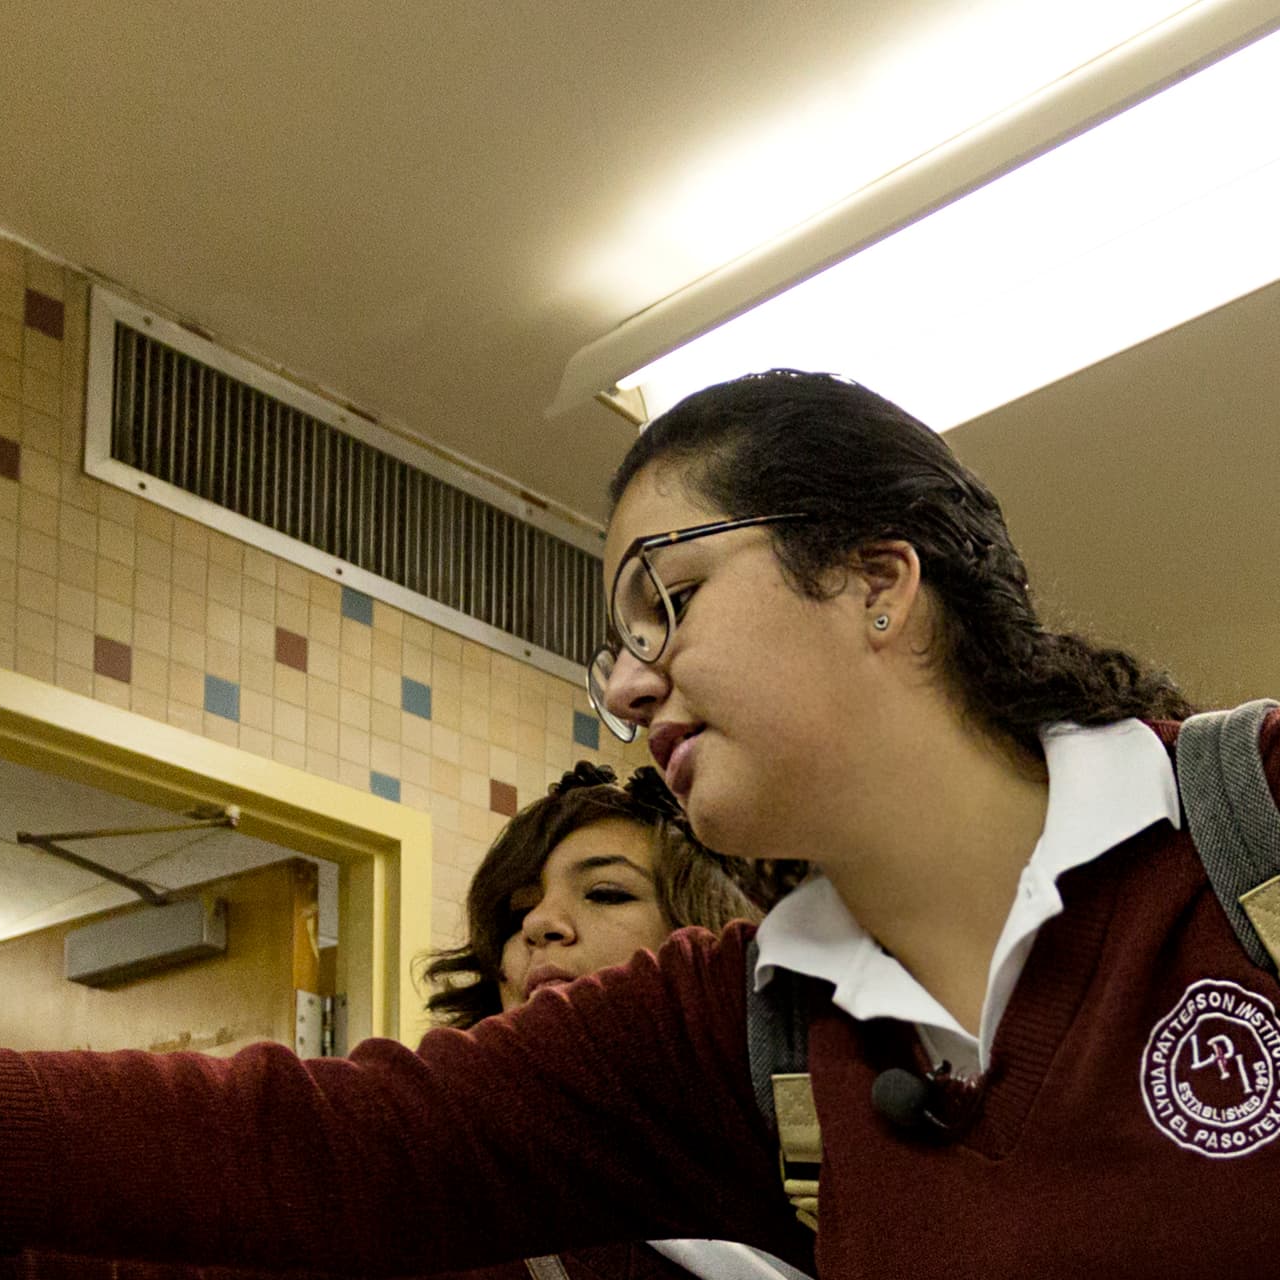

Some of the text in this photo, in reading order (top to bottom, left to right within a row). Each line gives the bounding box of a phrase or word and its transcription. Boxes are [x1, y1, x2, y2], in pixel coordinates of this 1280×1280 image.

[1152, 991, 1236, 1064] PATTERSON
[1150, 1066, 1174, 1117] LYDIA
[1179, 1082, 1261, 1121] ESTABLISHED
[1169, 1115, 1188, 1137] EL
